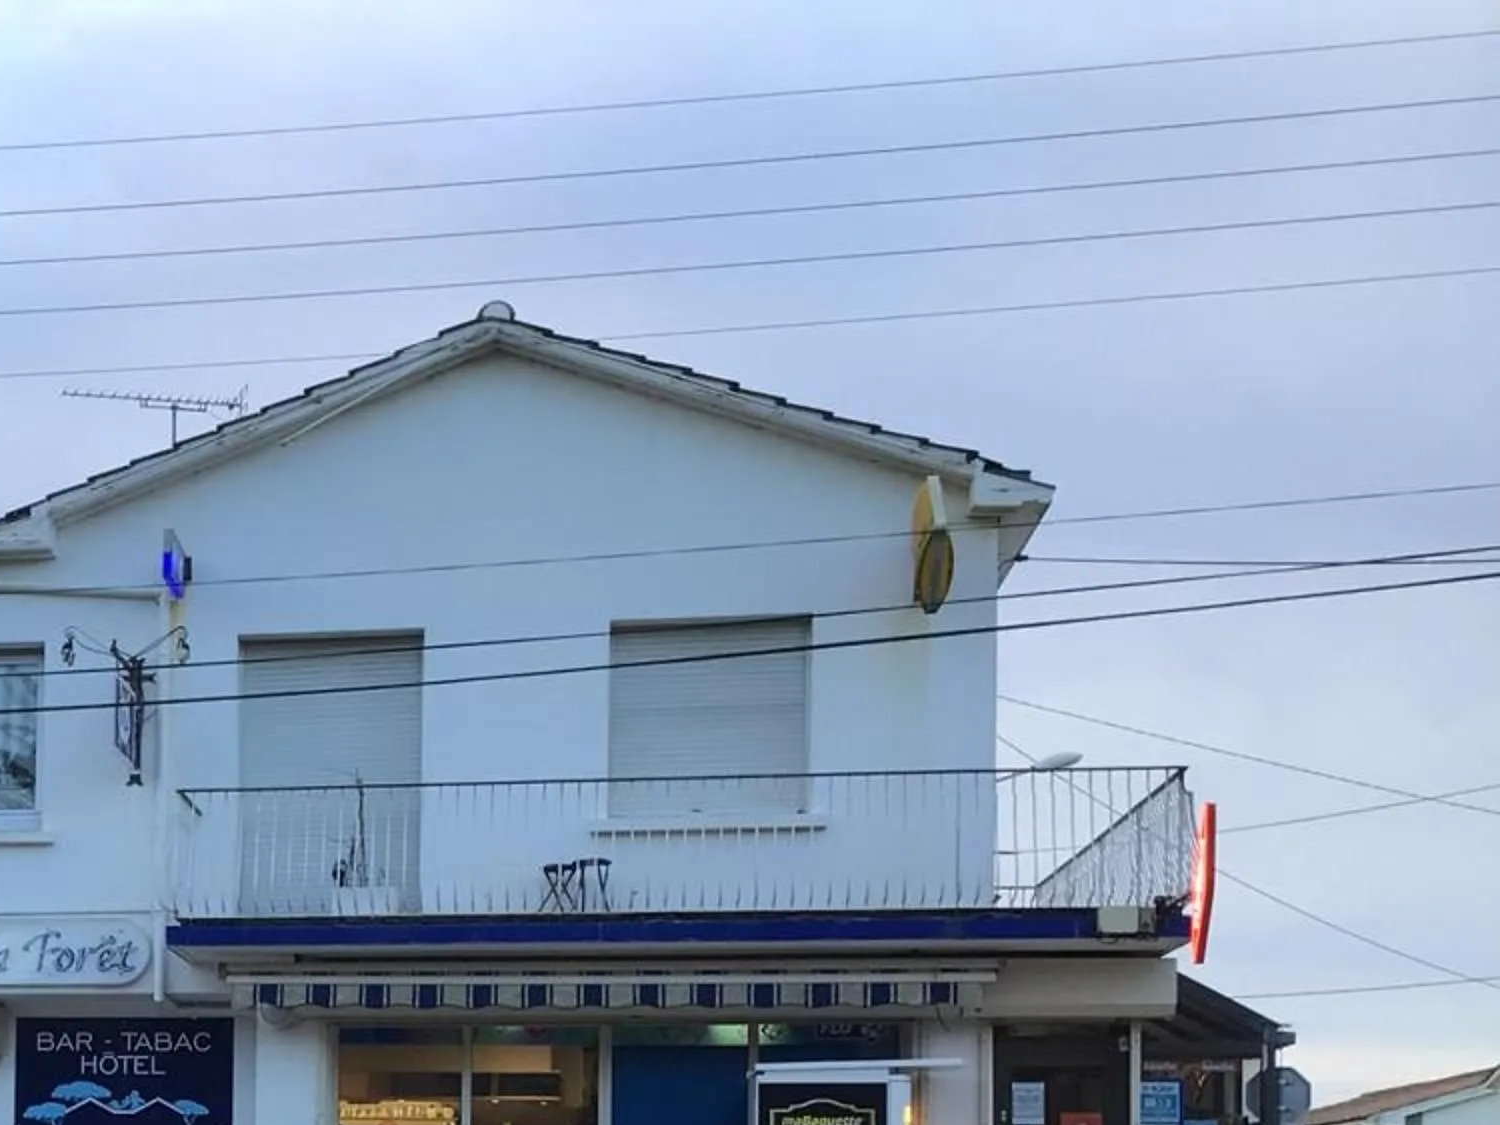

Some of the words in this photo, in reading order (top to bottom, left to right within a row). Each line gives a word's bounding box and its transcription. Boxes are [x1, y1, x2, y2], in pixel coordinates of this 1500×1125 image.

[23, 929, 141, 974] Forêt
[36, 1031, 93, 1052] BAR
[120, 1031, 212, 1052] TABAC
[80, 1052, 166, 1075] HÔTEL
